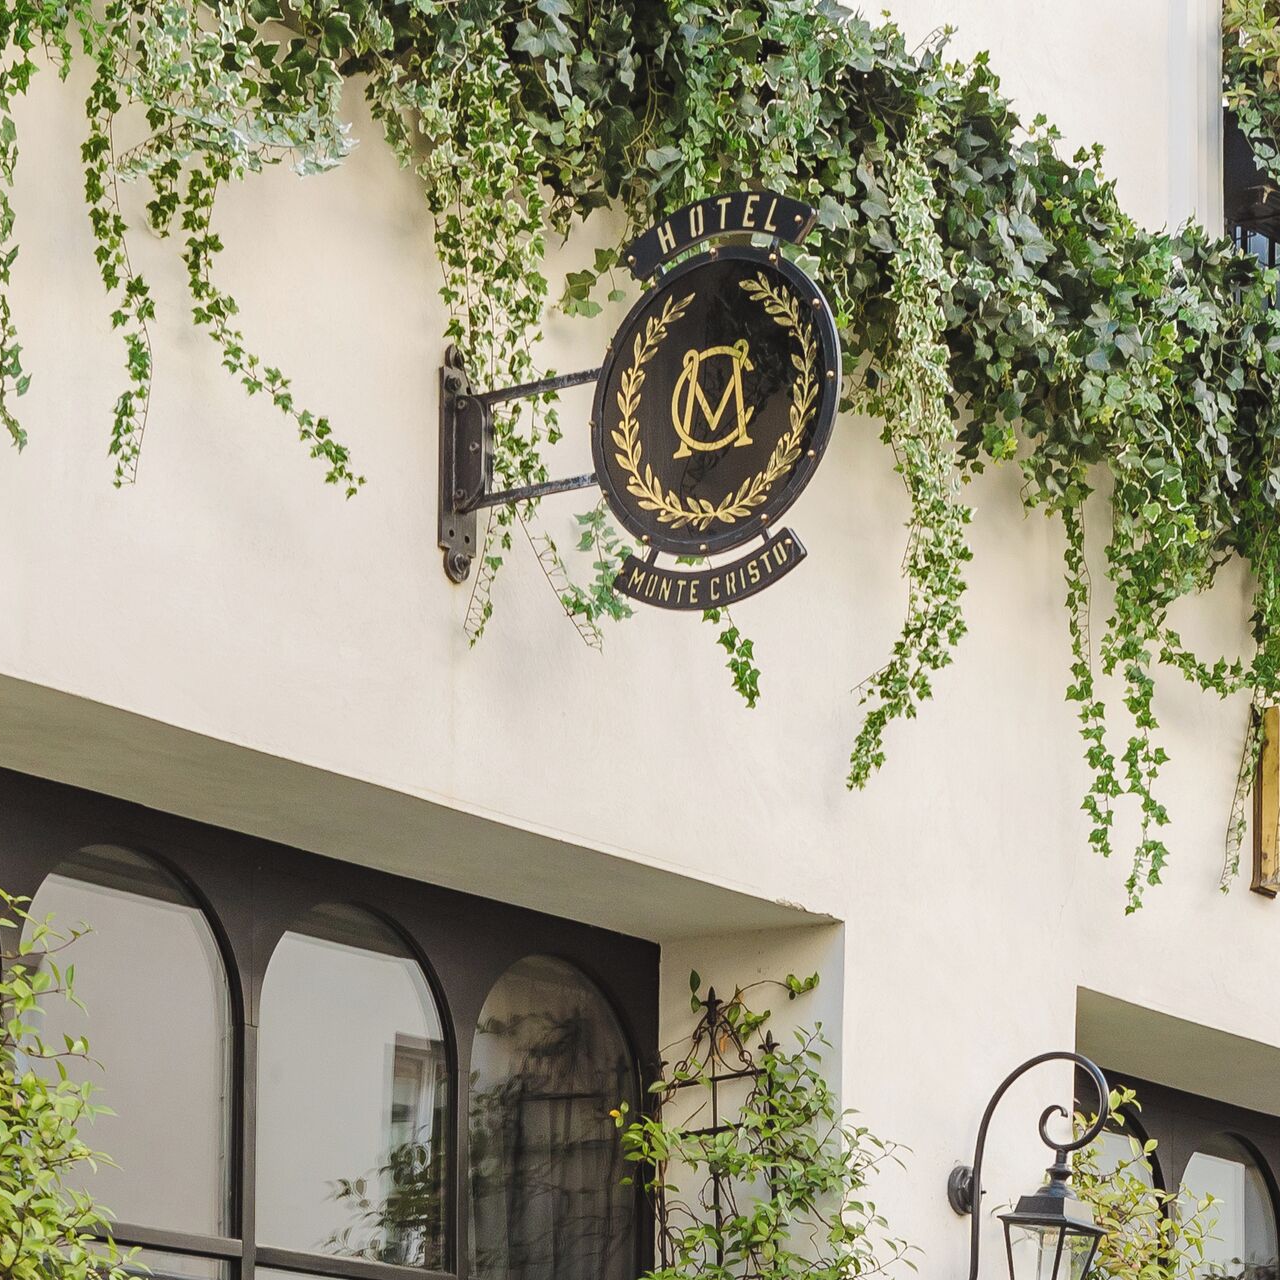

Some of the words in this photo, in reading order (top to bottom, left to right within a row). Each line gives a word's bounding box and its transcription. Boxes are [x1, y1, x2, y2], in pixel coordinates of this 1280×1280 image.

[656, 195, 778, 254] HOTEL
[627, 566, 700, 604] MONTE
[710, 541, 788, 601] CRISTO
